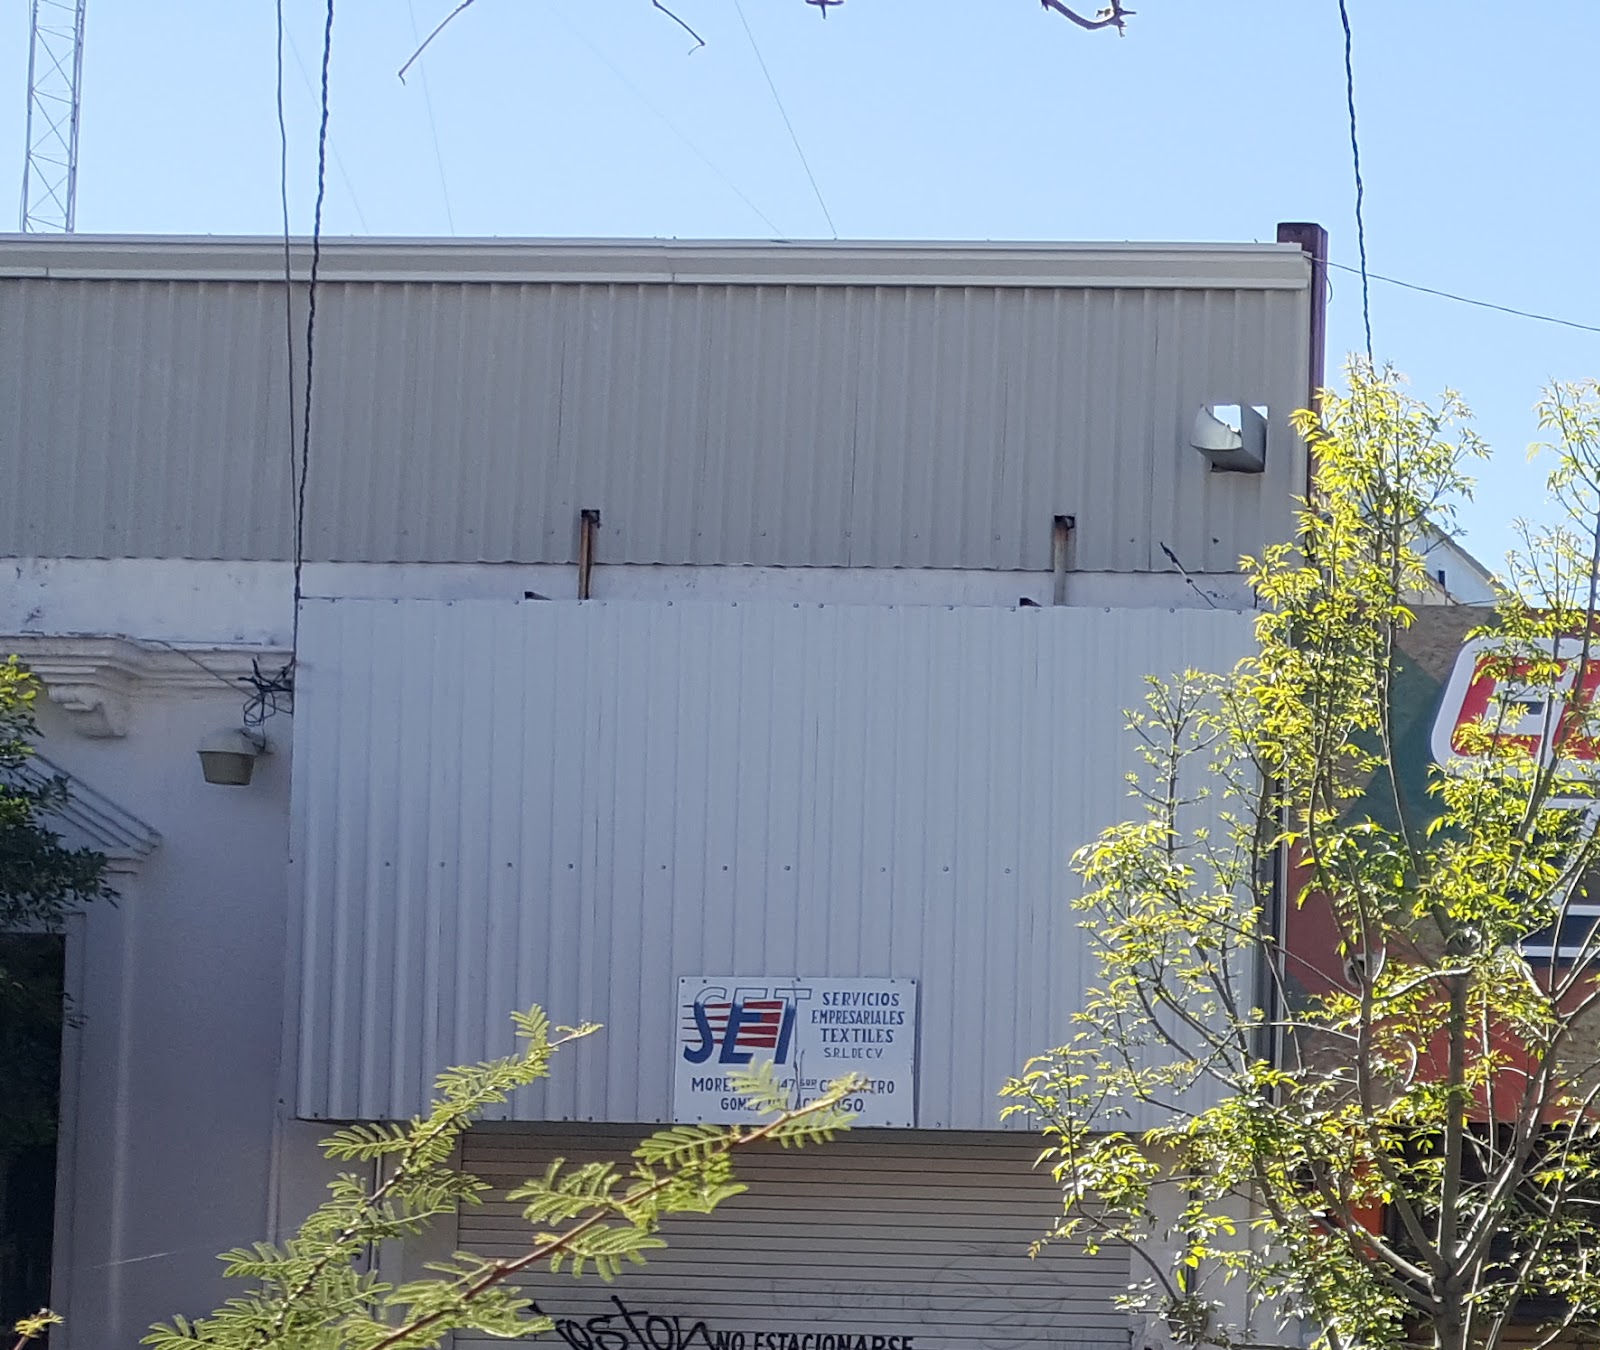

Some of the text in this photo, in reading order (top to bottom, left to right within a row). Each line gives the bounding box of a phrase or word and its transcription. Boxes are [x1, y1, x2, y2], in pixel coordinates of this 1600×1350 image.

[822, 992, 900, 1007] SERVICIOS
[682, 986, 812, 1064] SET
[811, 1009, 905, 1026] EMPRESARIALES
[820, 1028, 895, 1043] TEXTILES
